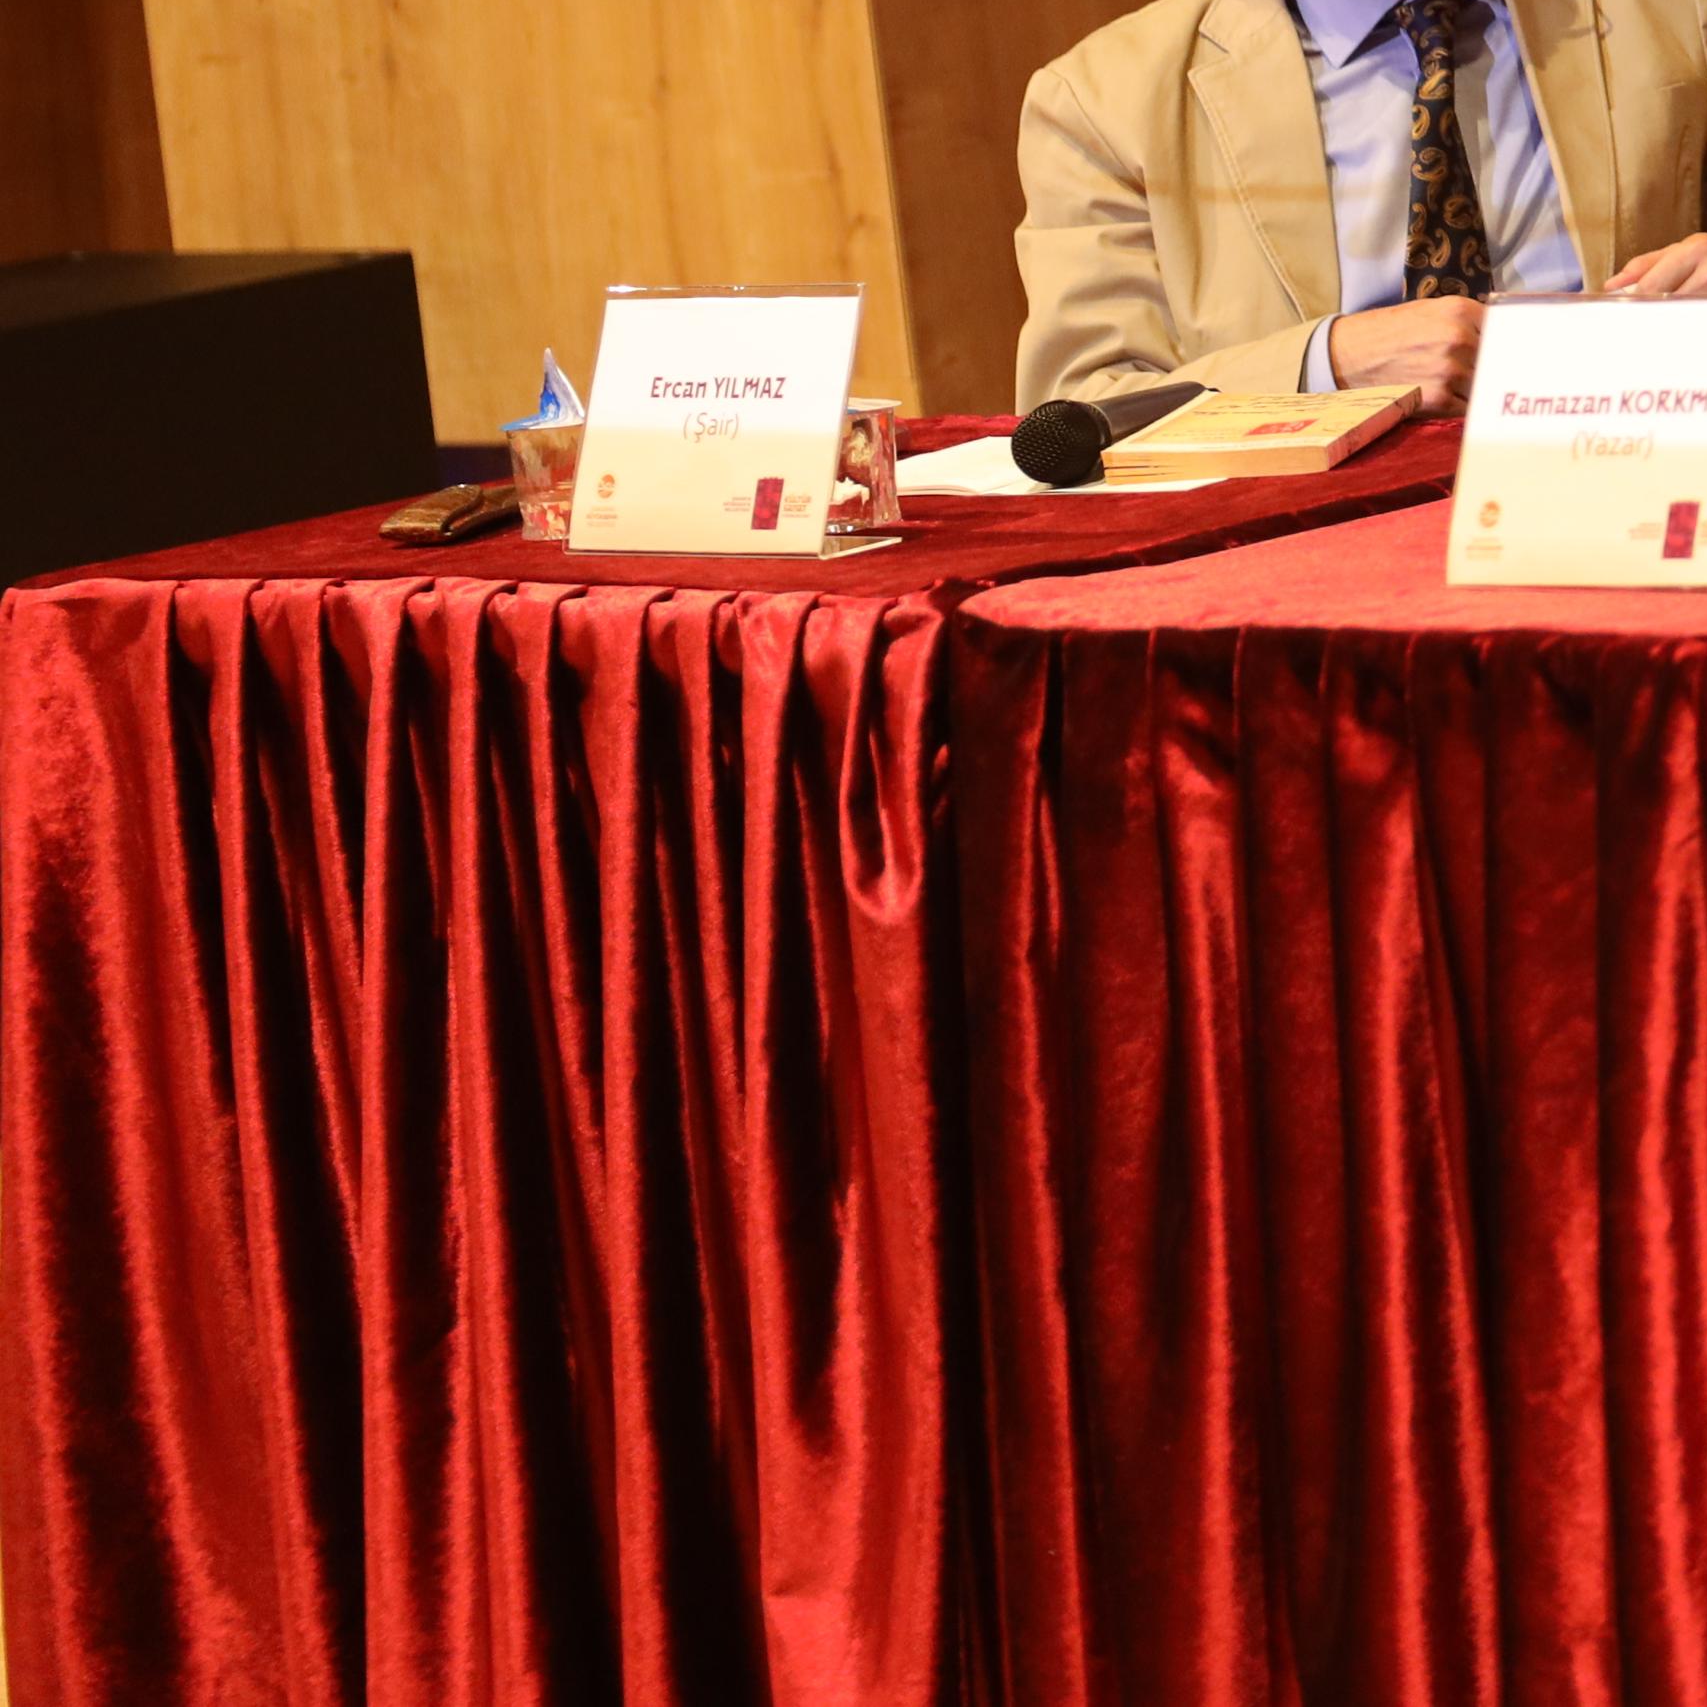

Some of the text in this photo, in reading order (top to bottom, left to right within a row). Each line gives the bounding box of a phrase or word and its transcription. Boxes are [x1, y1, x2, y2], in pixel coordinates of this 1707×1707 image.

[650, 376, 787, 399] Ercan YILMAZ
[1501, 391, 1613, 416] Ramazan
[1570, 431, 1655, 462] (Yazar)
